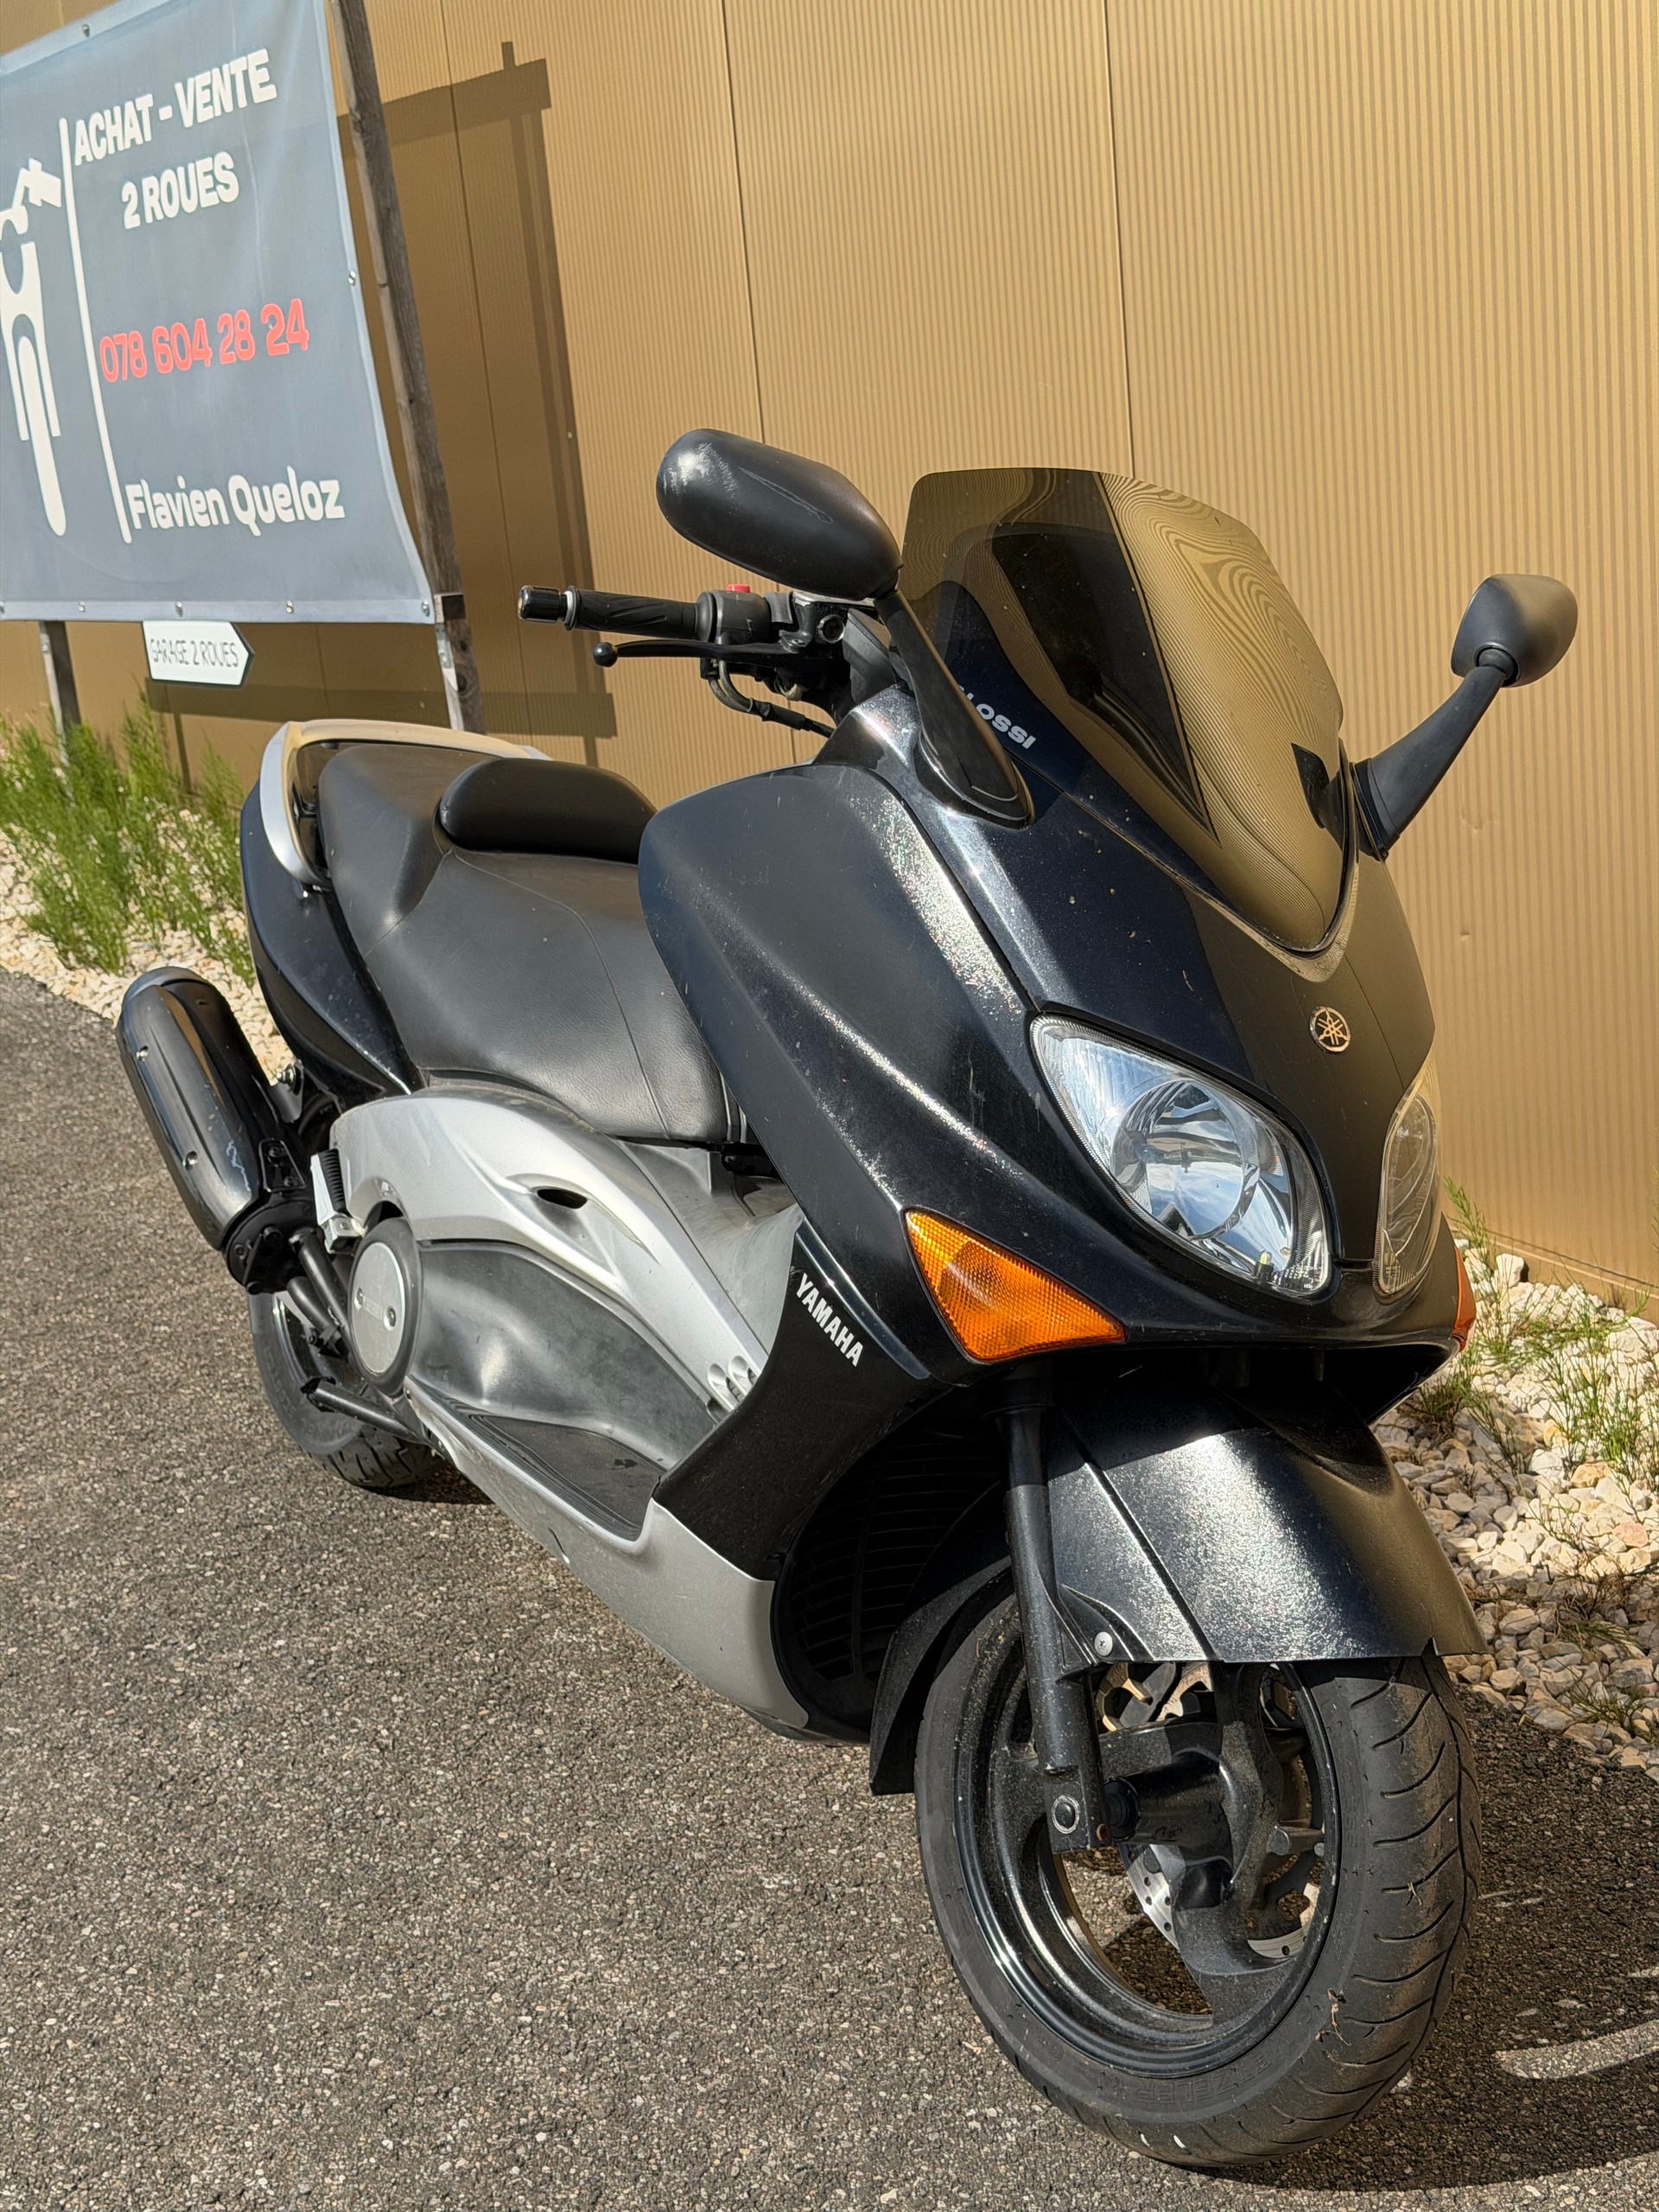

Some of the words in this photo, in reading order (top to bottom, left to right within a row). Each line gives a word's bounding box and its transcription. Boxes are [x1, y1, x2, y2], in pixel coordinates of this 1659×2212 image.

[75, 93, 154, 166] ACHAT
[175, 48, 277, 128] VENTE
[122, 181, 141, 229] 2
[142, 151, 239, 224] ROUES
[99, 330, 147, 382] 078
[151, 317, 213, 375] 604
[217, 308, 255, 365] 28
[260, 298, 309, 356] 24
[125, 475, 230, 530] Flavien
[228, 465, 346, 537] Queloz
[150, 639, 189, 664] GARAGE
[190, 640, 200, 665] 2
[200, 640, 238, 667] ROUES
[796, 1272, 863, 1367] YAMAHA
